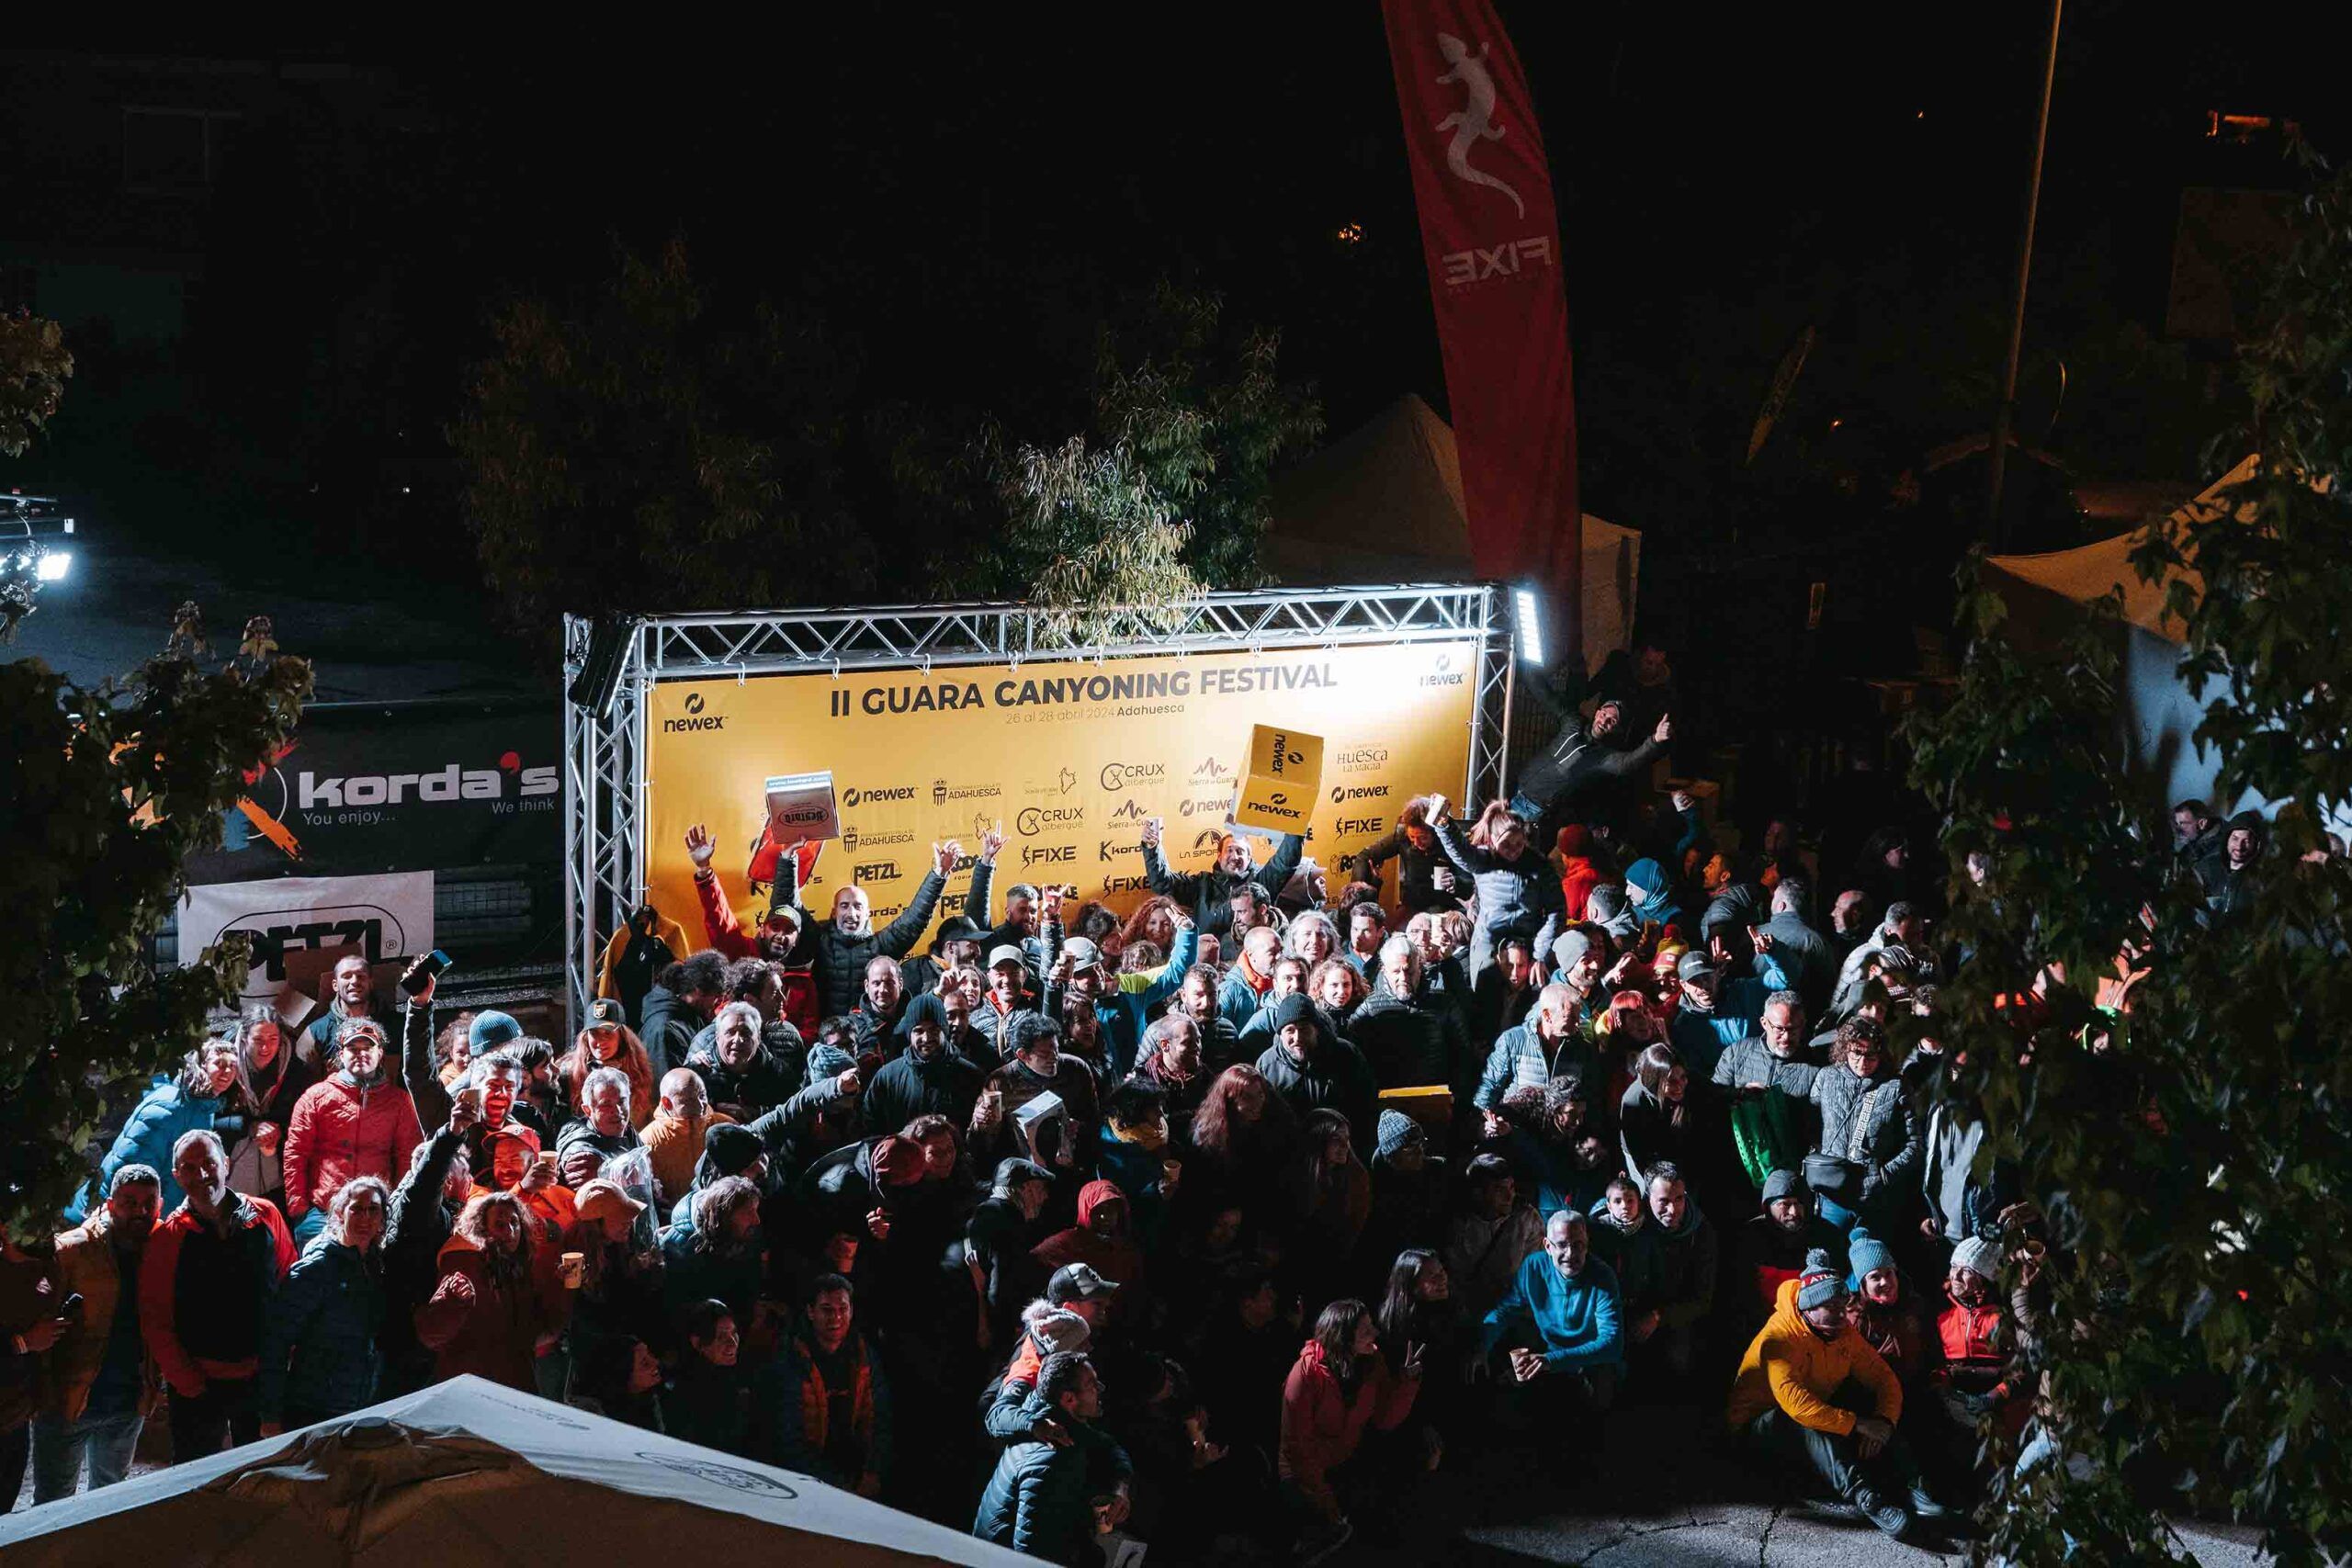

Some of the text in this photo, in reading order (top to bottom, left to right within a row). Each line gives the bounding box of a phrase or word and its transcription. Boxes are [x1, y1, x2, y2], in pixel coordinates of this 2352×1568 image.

[831, 663, 1338, 716] II GUARA CANYONING FESTIVAL
[1006, 705, 1184, 724] 26 al 28 abril 2024 Adahuesca
[664, 716, 723, 732] newex
[1272, 734, 1286, 773] newex
[1125, 764, 1165, 777] CRUX
[299, 751, 560, 809] korda's
[864, 787, 915, 802] newex
[948, 788, 1001, 800] ADAHUESCA
[1347, 785, 1389, 800] newex
[492, 798, 555, 814] We think
[1196, 799, 1231, 812] newe
[1248, 801, 1301, 818] newex
[302, 809, 396, 826] You enjoy...
[1042, 807, 1084, 822] CRUX
[1042, 820, 1084, 831] albergue
[1344, 818, 1383, 834] FIXE
[859, 834, 915, 846] ADAHUESCA
[1032, 846, 1077, 863] FIXE
[854, 863, 903, 887] PETZL
[1113, 875, 1151, 893] FIXE
[941, 893, 968, 919] PET
